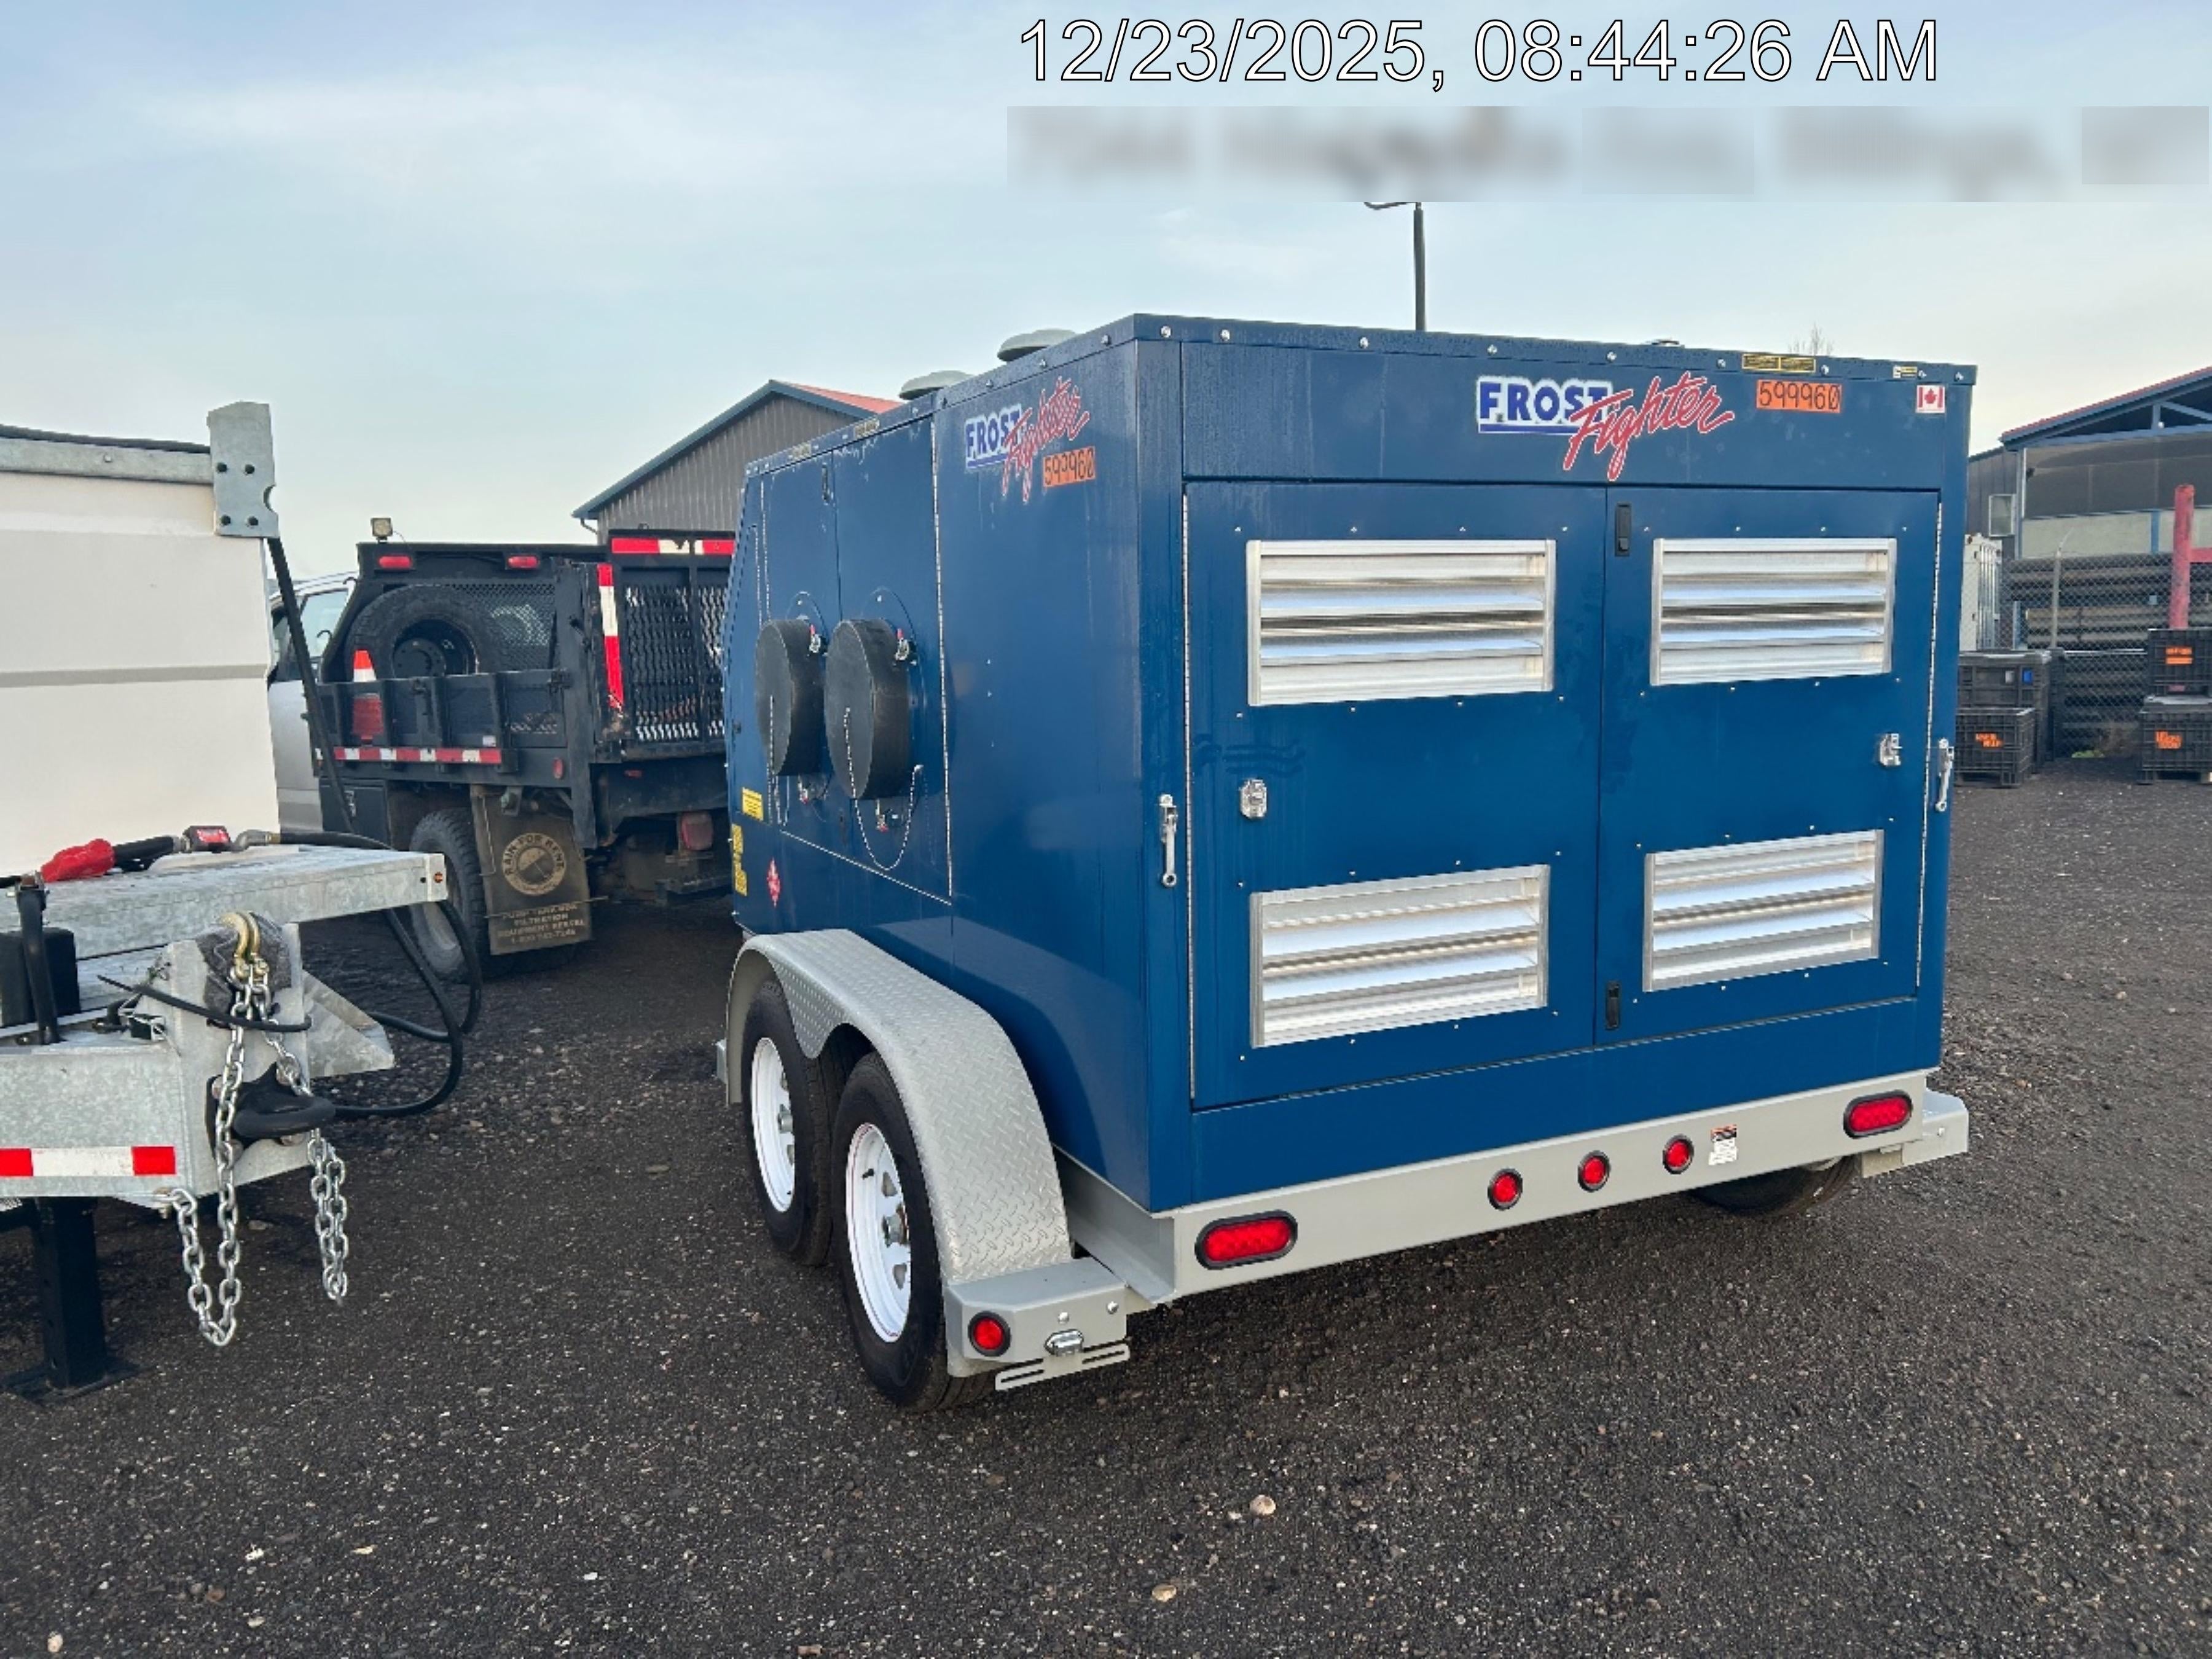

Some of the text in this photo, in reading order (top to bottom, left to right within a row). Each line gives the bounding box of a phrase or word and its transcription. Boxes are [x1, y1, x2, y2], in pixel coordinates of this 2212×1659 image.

[1759, 380, 1840, 410] 599960
[965, 409, 1021, 458] FROST
[1480, 371, 1735, 482] FROST Fighter
